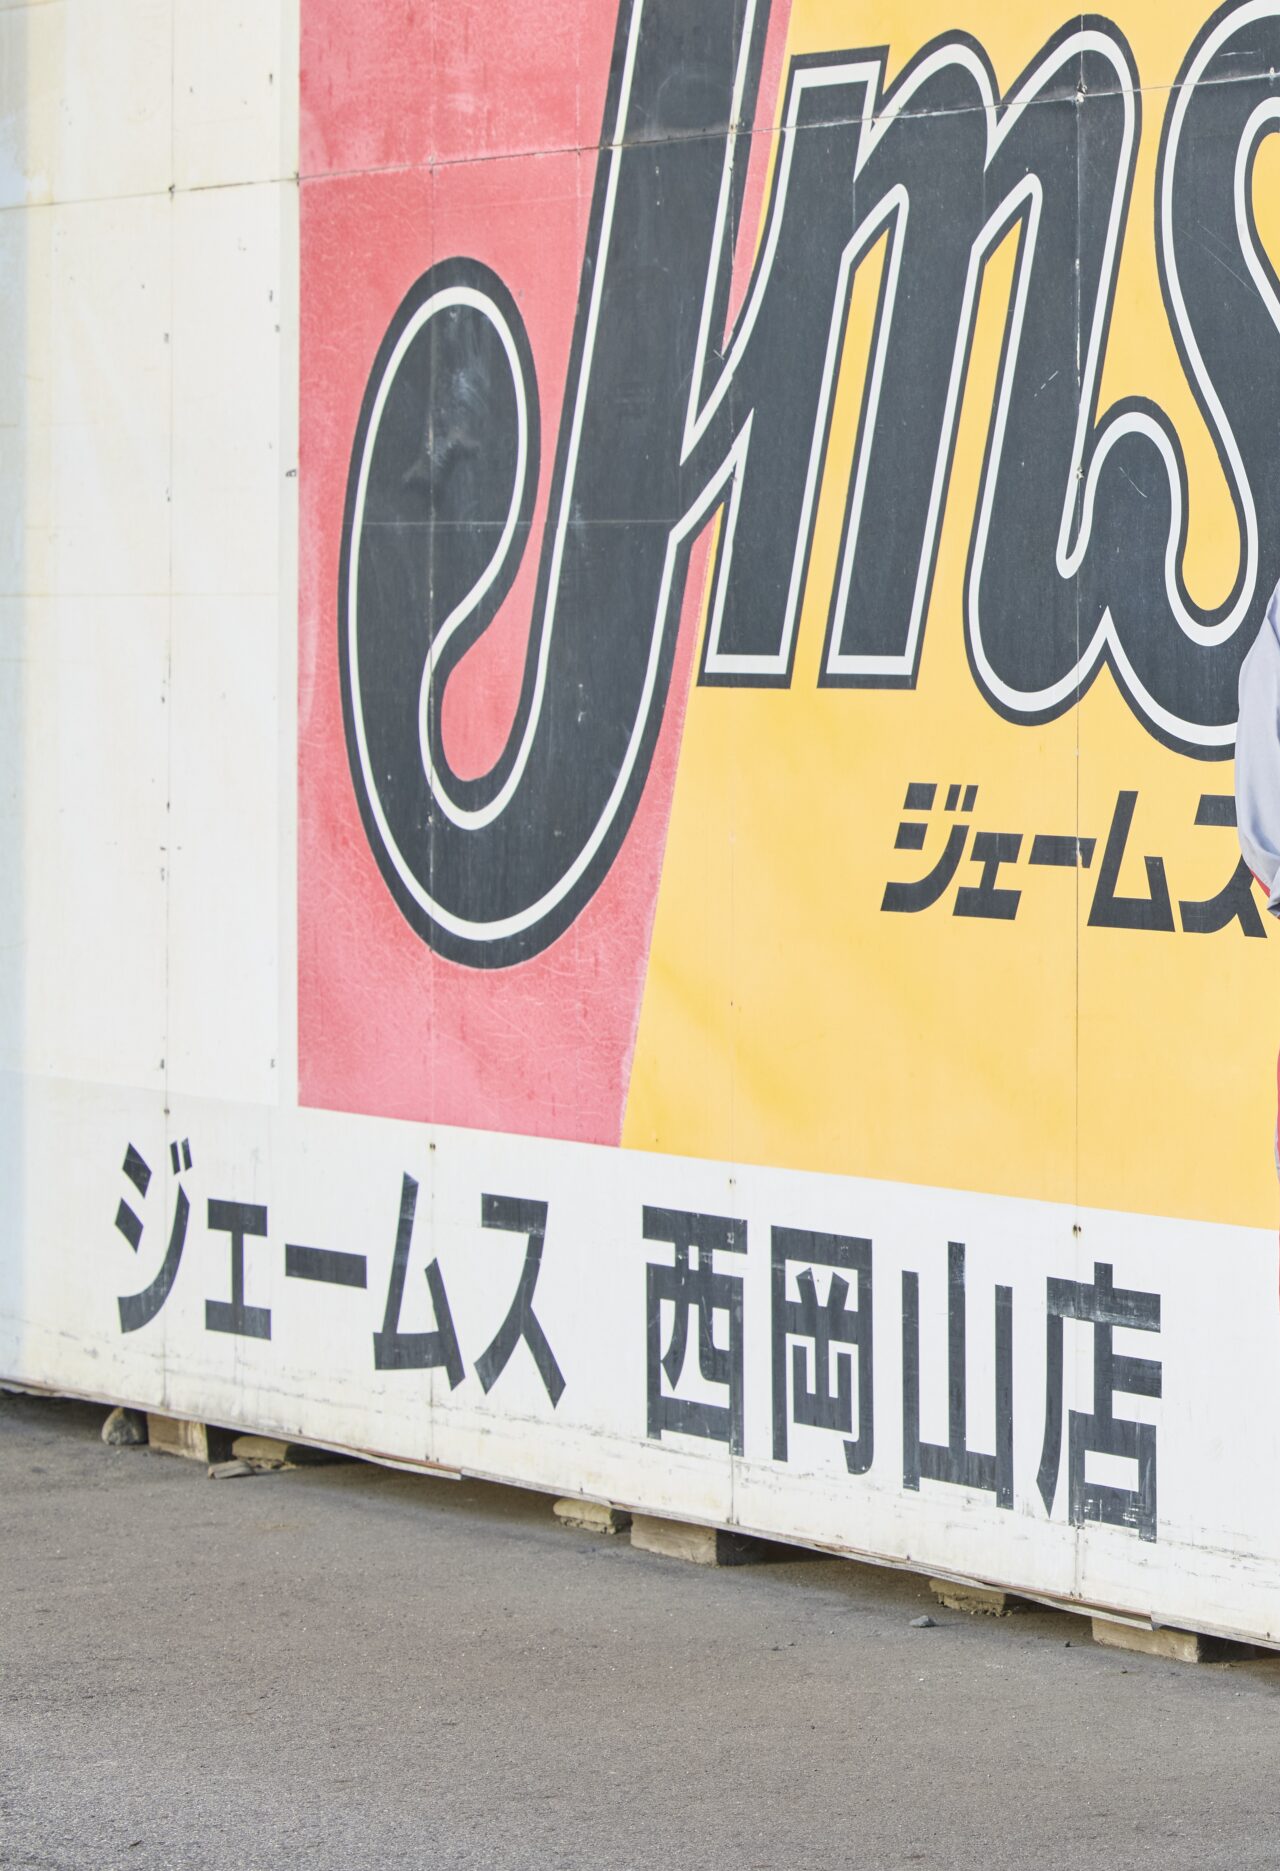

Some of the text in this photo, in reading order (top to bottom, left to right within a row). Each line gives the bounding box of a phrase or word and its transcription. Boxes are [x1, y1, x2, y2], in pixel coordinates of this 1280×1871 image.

[880, 782, 1268, 938] ジェームス
[115, 1137, 1163, 1543] ジェームス 西岡山店
